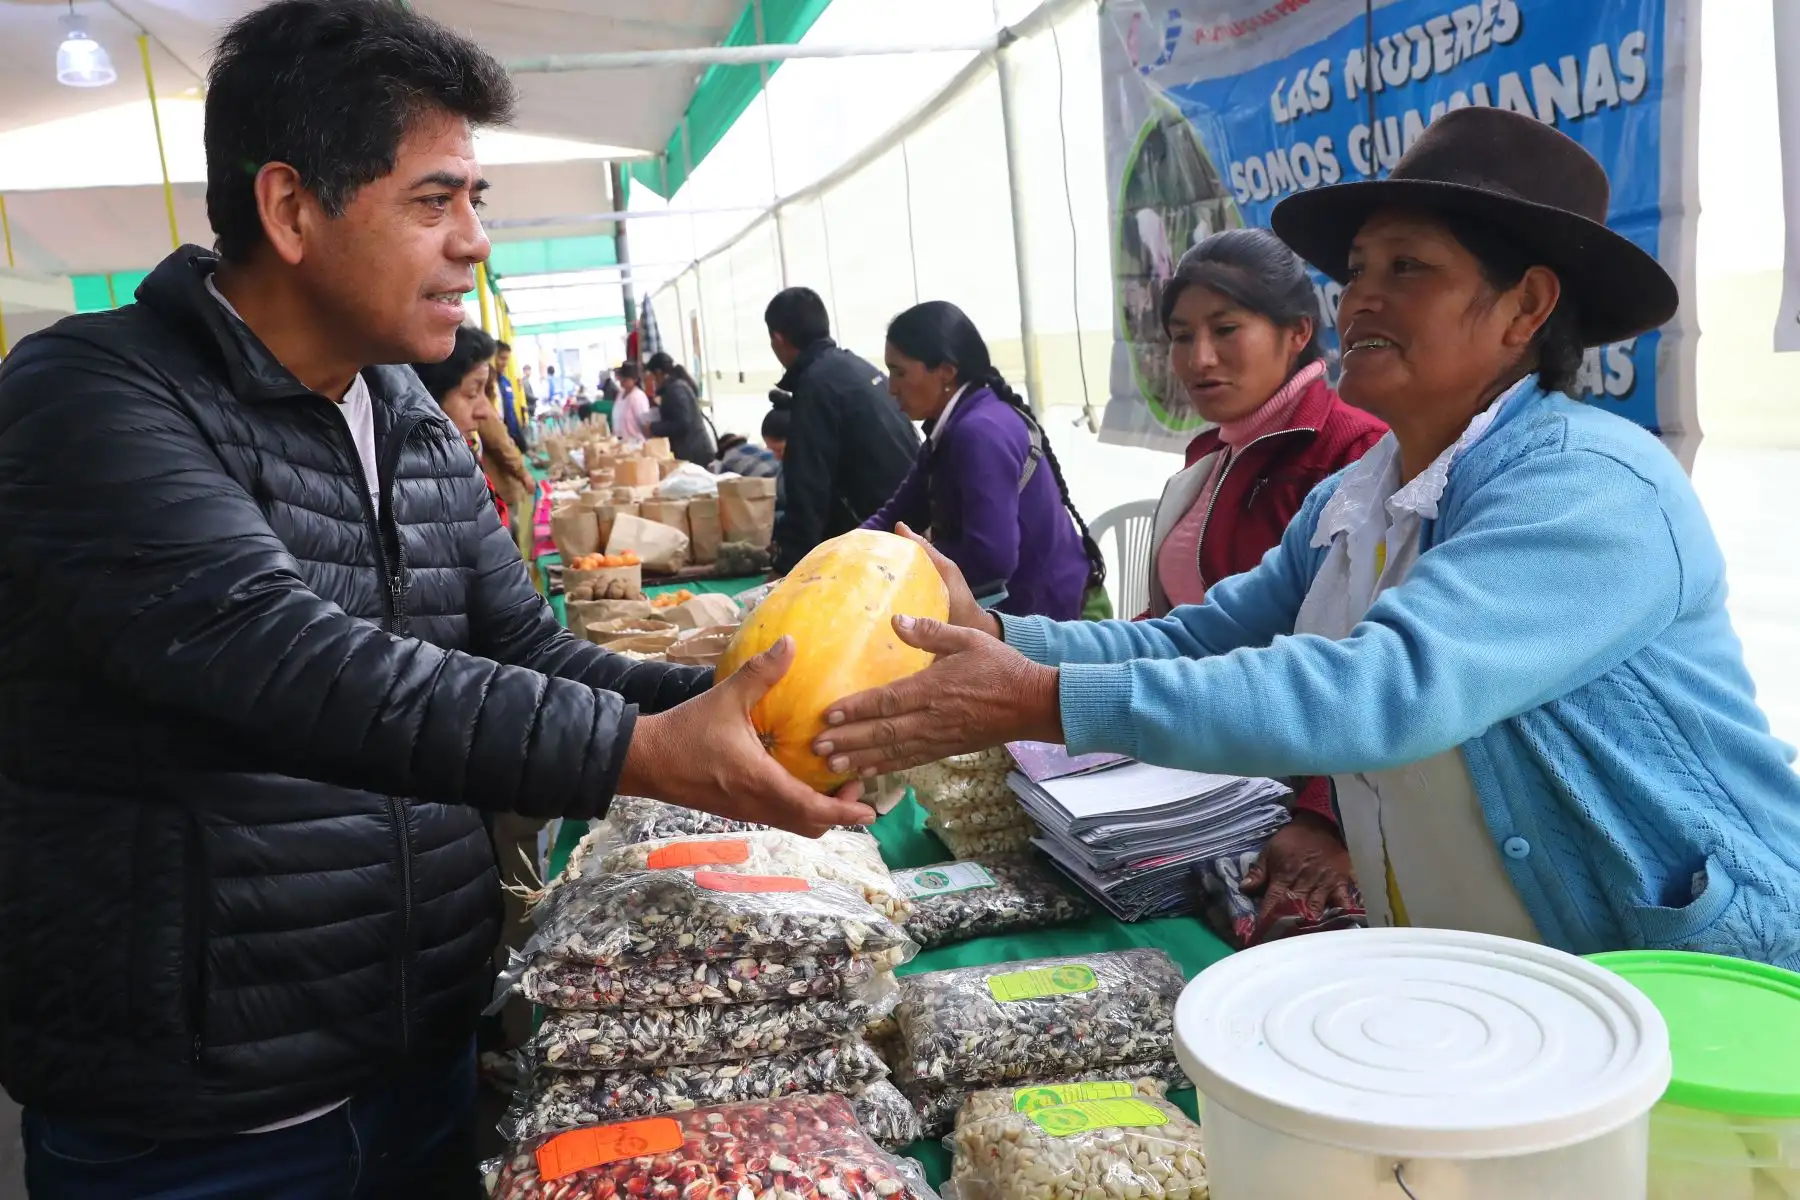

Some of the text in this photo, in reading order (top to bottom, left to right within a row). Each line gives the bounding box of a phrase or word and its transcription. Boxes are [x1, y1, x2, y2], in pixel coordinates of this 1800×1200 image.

[1271, 58, 1331, 124] LAS
[1344, 0, 1520, 99] MUJERES
[1230, 135, 1341, 204] SOMOS
